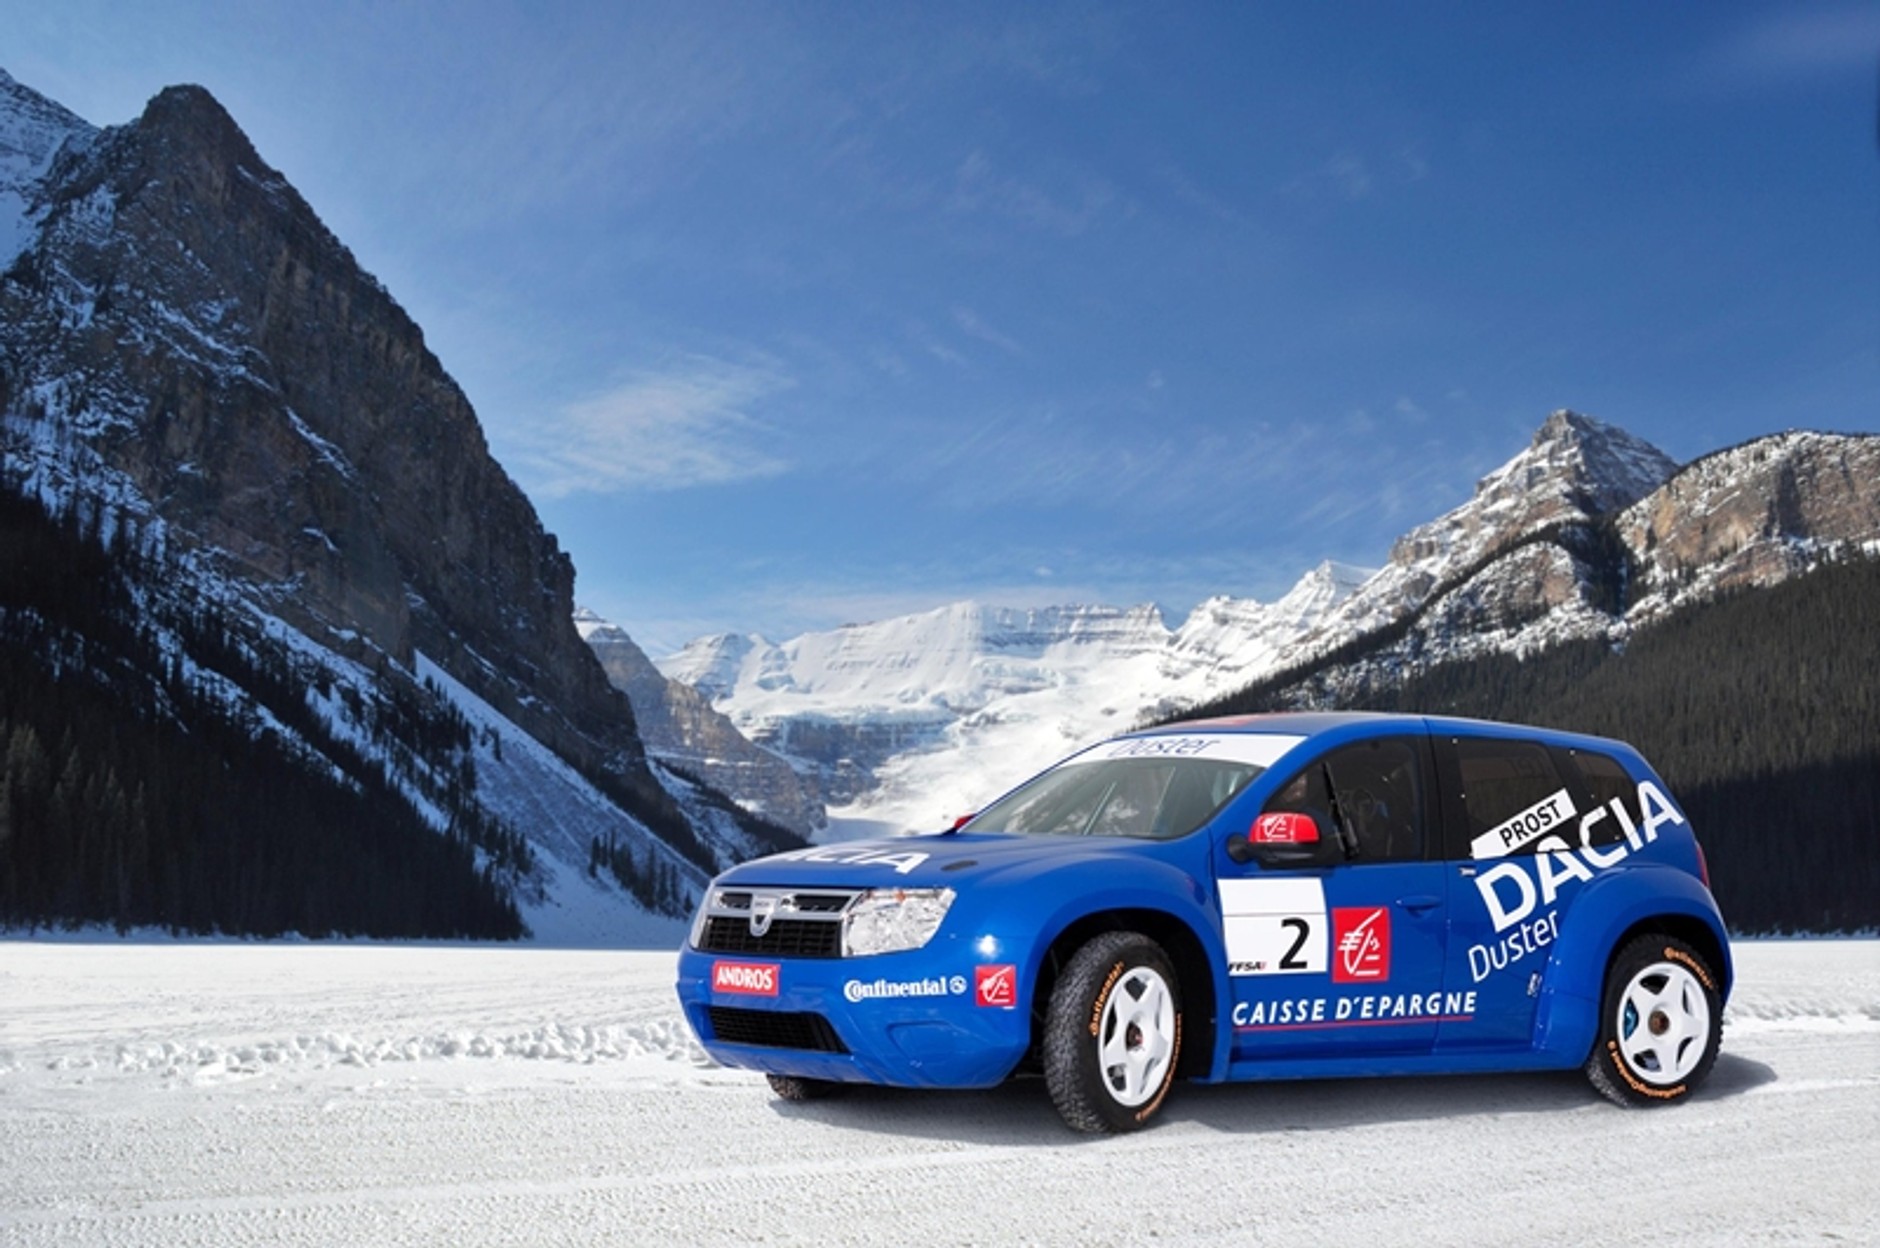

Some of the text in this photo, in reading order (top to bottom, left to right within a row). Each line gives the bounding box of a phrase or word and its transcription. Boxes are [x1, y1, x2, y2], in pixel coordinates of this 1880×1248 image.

[1108, 737, 1220, 757] Duster
[1499, 799, 1563, 848] PROST
[1475, 780, 1684, 934] DACIA
[1278, 917, 1310, 969] 2
[1468, 910, 1558, 983] Duster
[716, 967, 773, 990] ANDROS
[1228, 961, 1262, 972] FFSA
[844, 976, 948, 1003] Continental
[1231, 991, 1477, 1026] CAISSE D'EPARGNE
